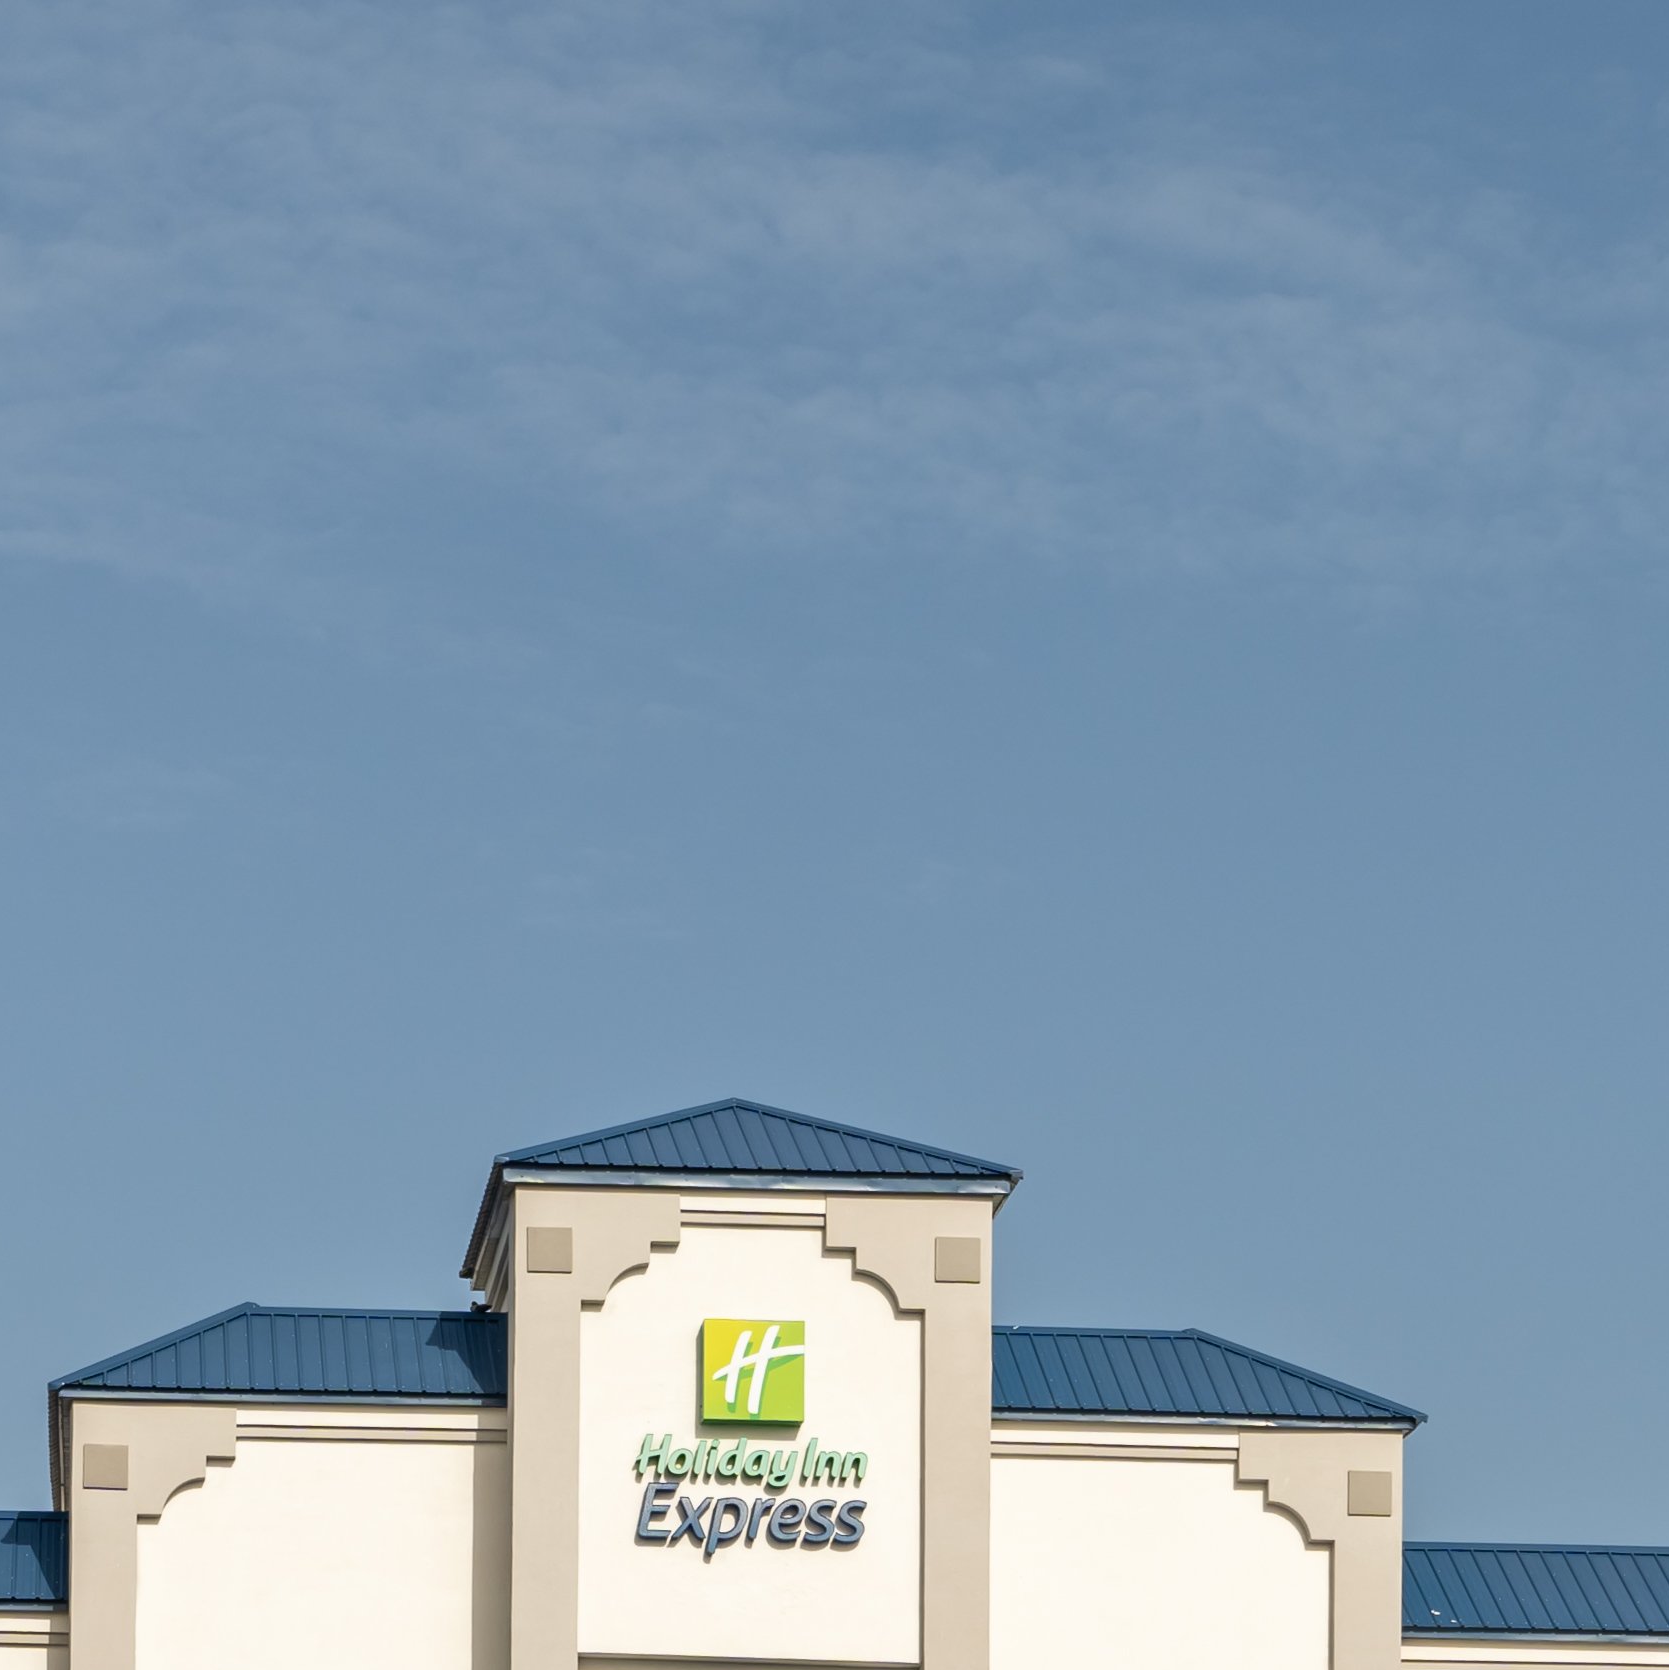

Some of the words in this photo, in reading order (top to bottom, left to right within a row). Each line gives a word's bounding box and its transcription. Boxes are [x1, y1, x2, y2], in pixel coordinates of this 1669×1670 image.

[634, 1434, 799, 1487] Holiday
[802, 1437, 868, 1481] Inn
[637, 1482, 868, 1556] Express
